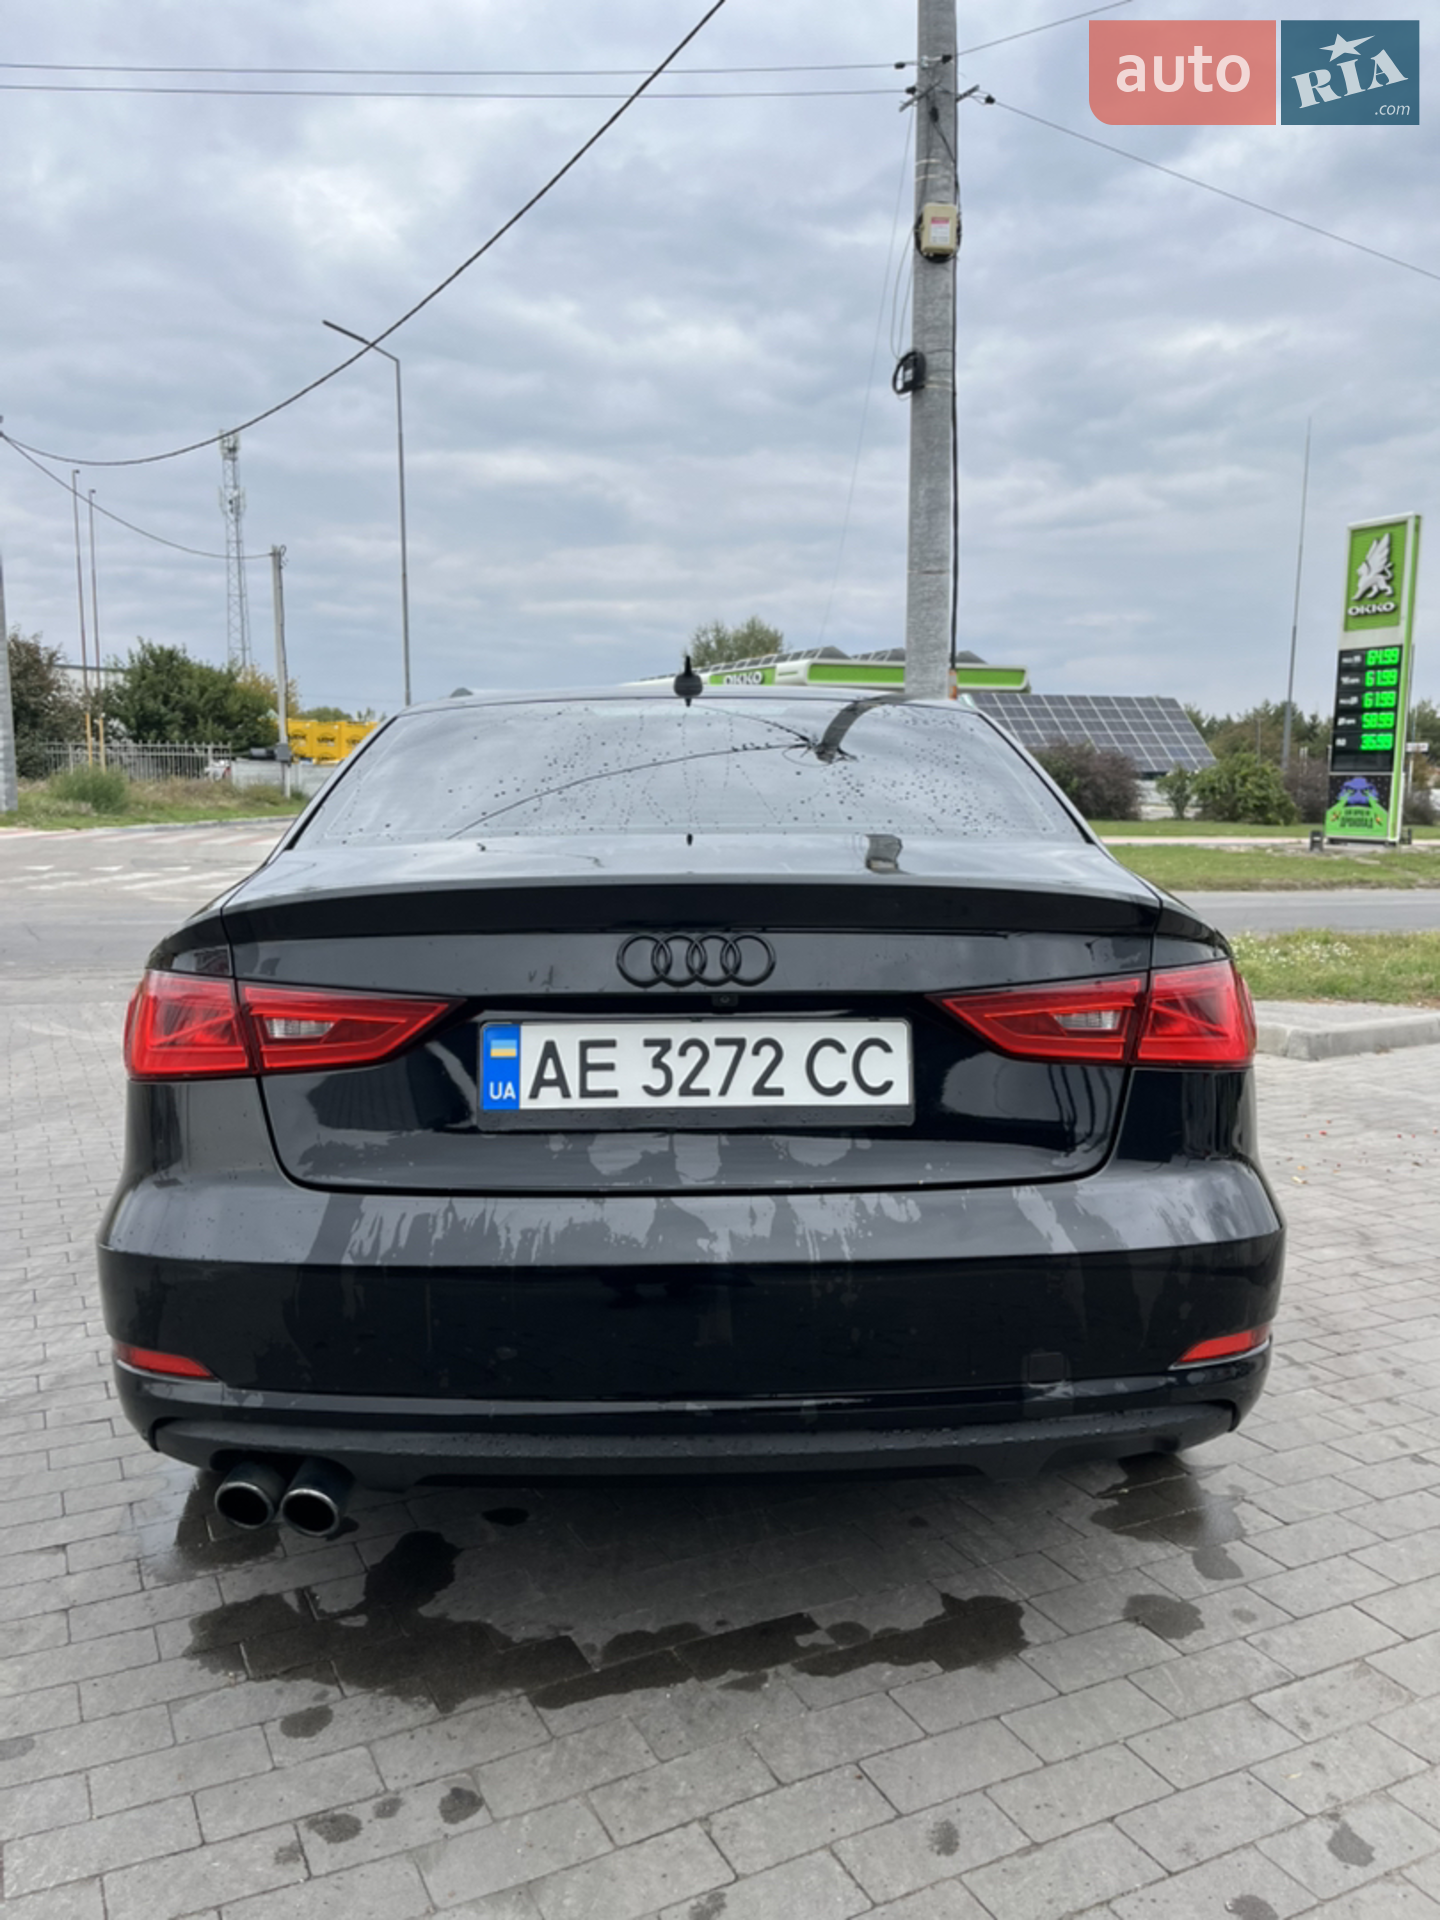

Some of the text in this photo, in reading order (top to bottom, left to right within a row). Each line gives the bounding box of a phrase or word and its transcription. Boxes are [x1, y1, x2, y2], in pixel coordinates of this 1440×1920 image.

[1347, 602, 1396, 616] OKKO
[724, 671, 763, 685] OKKO
[528, 1037, 894, 1099] AE 3272 CC
[489, 1082, 516, 1100] UA
